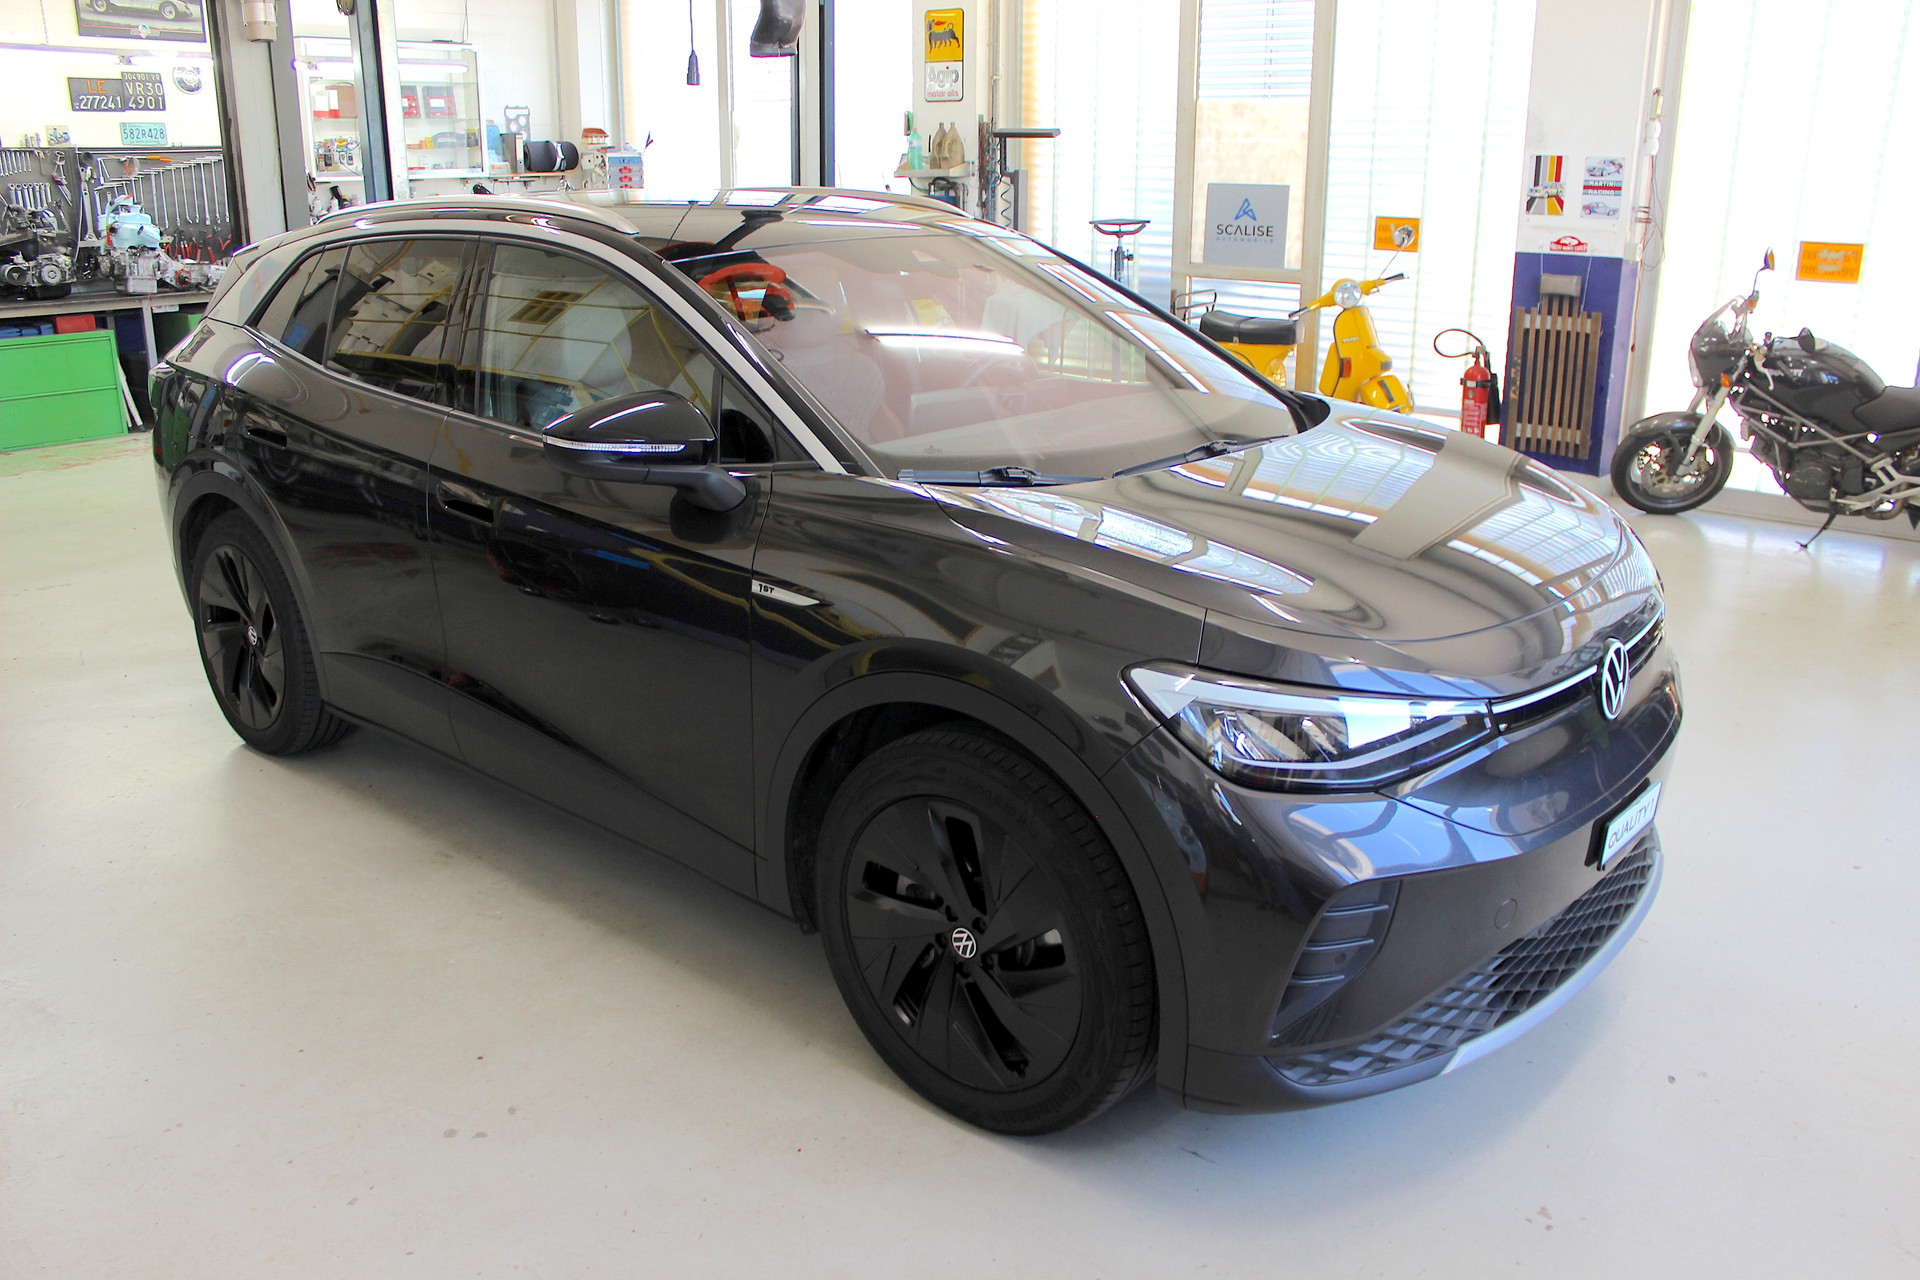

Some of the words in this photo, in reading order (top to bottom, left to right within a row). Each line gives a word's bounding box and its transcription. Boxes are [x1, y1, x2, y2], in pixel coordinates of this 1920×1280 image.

[928, 66, 960, 88] Agip
[86, 80, 107, 94] LE
[125, 82, 163, 95] VR30
[79, 95, 122, 110] 277241
[129, 96, 163, 109] 4901
[123, 128, 165, 140] 582R428
[1216, 224, 1274, 237] SCALISE
[758, 583, 775, 594] 1ST
